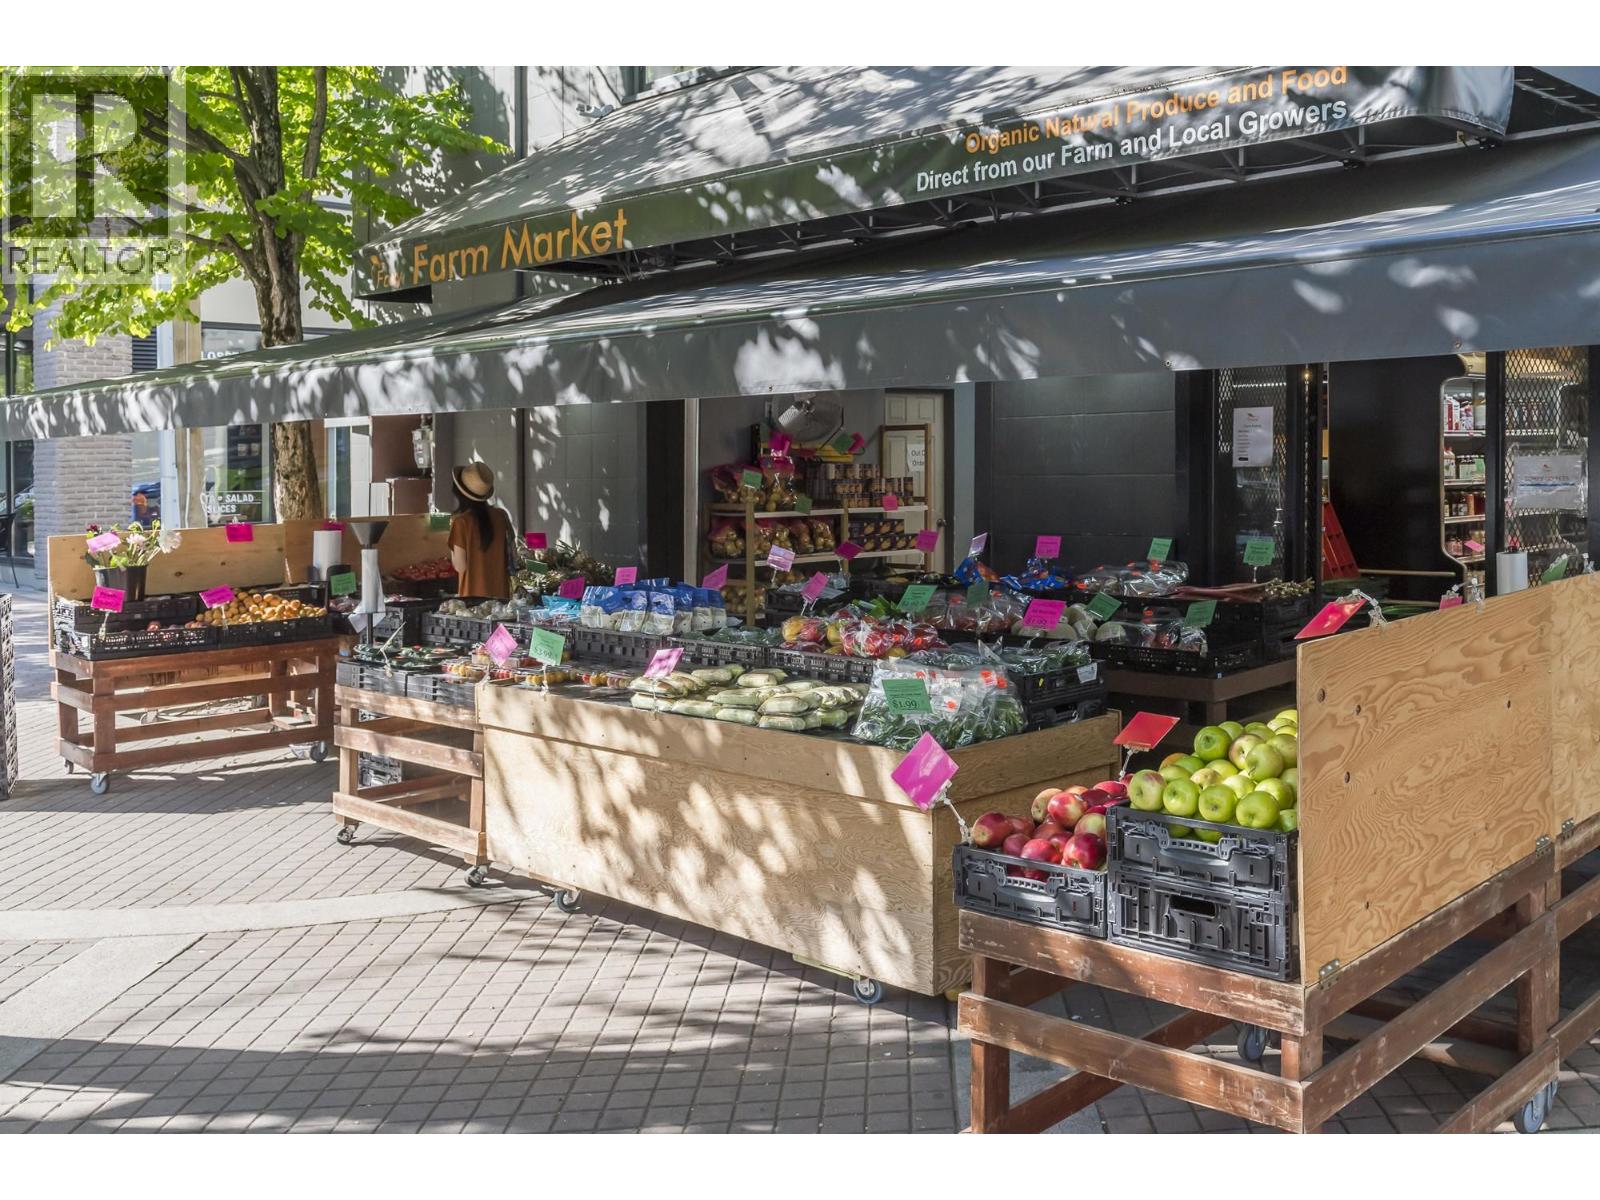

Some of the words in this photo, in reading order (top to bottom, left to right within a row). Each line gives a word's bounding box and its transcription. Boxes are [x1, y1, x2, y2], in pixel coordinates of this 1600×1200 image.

[916, 165, 969, 193] Direct
[974, 158, 1017, 182] from
[1022, 151, 1055, 173] our
[1061, 140, 1113, 166] Farm
[1120, 128, 1162, 156] and
[1169, 118, 1231, 148] Local
[1239, 98, 1347, 133] Growers
[965, 124, 1039, 155] Organic
[1046, 106, 1119, 138] Natural
[1126, 90, 1219, 125] Produce
[1228, 79, 1277, 105] and
[1280, 66, 1348, 98] Food
[413, 242, 489, 285] Farm
[501, 208, 628, 268] Market
[226, 494, 253, 503] SALAD
[892, 699, 918, 709] $1.99
